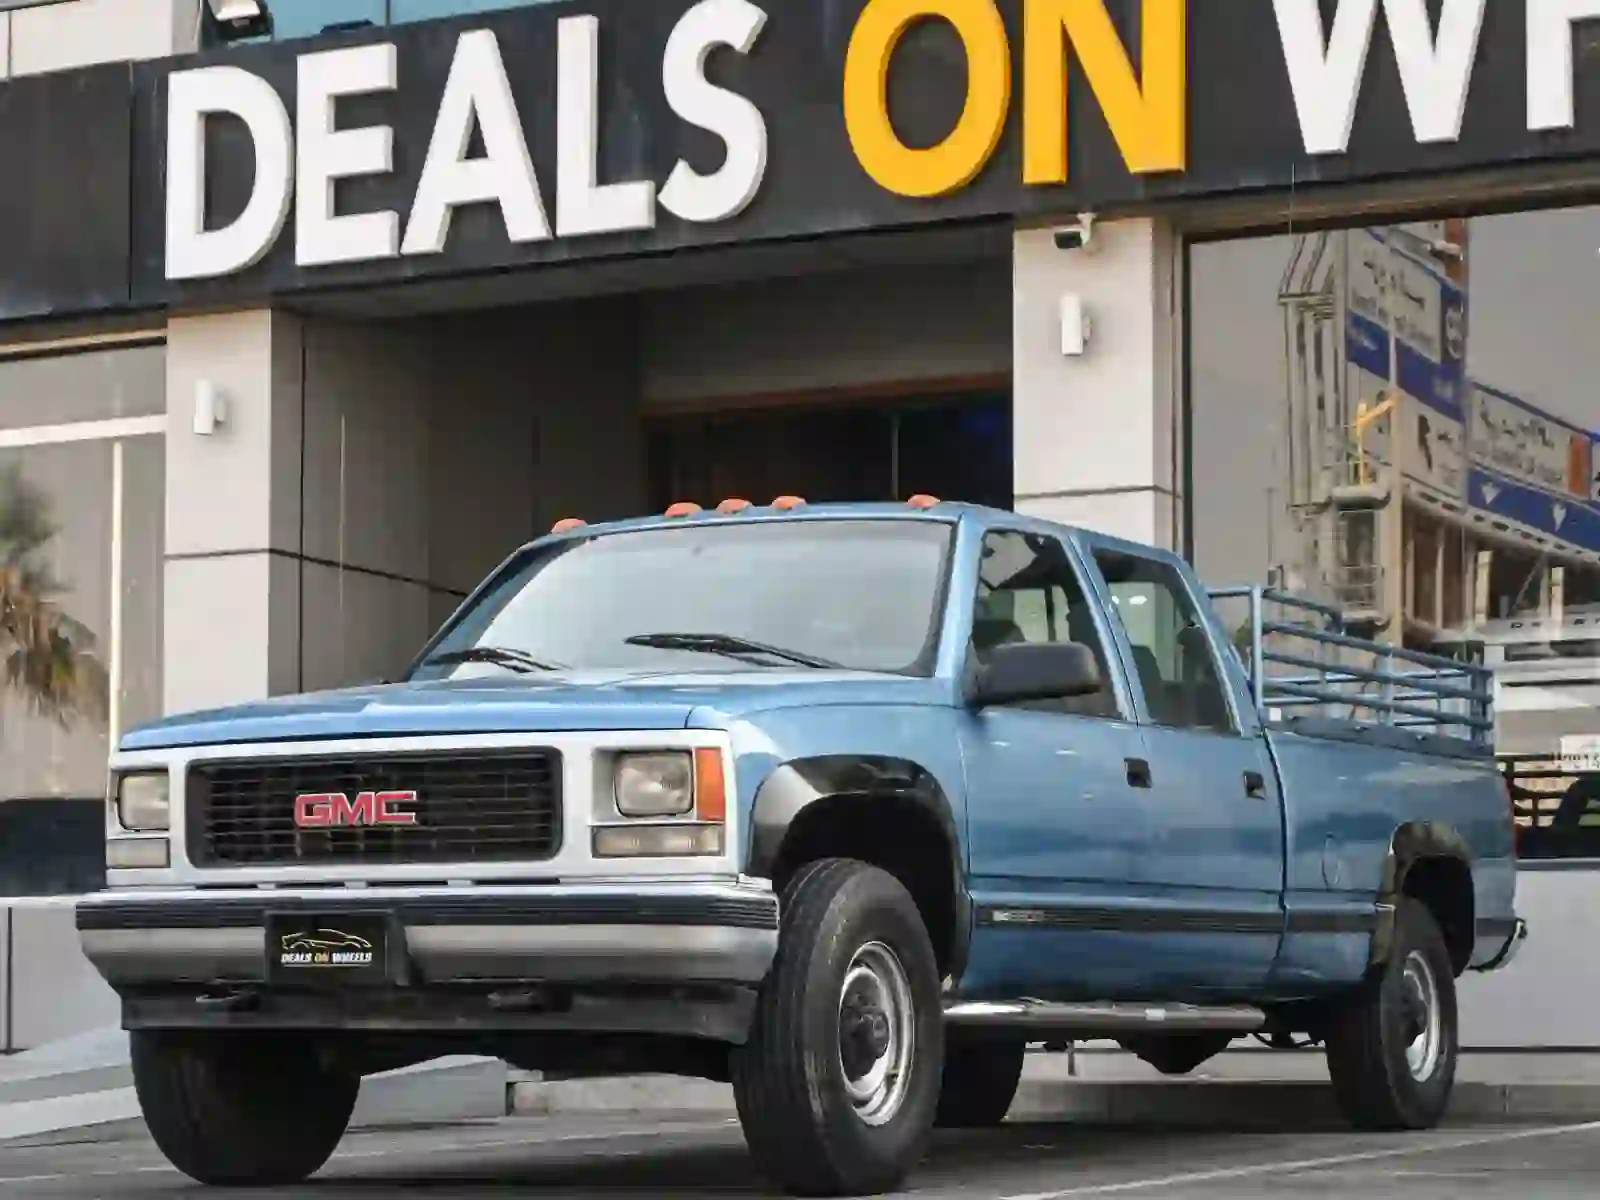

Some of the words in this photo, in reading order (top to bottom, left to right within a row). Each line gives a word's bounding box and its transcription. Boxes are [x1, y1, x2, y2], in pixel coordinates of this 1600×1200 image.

[164, 0, 768, 280] DEALS
[843, 0, 1187, 198] ON
[1272, 0, 1600, 155] W
[293, 790, 418, 828] GMC
[280, 952, 313, 964] DEALS
[314, 951, 330, 964] ON
[332, 952, 373, 964] WHEELS
